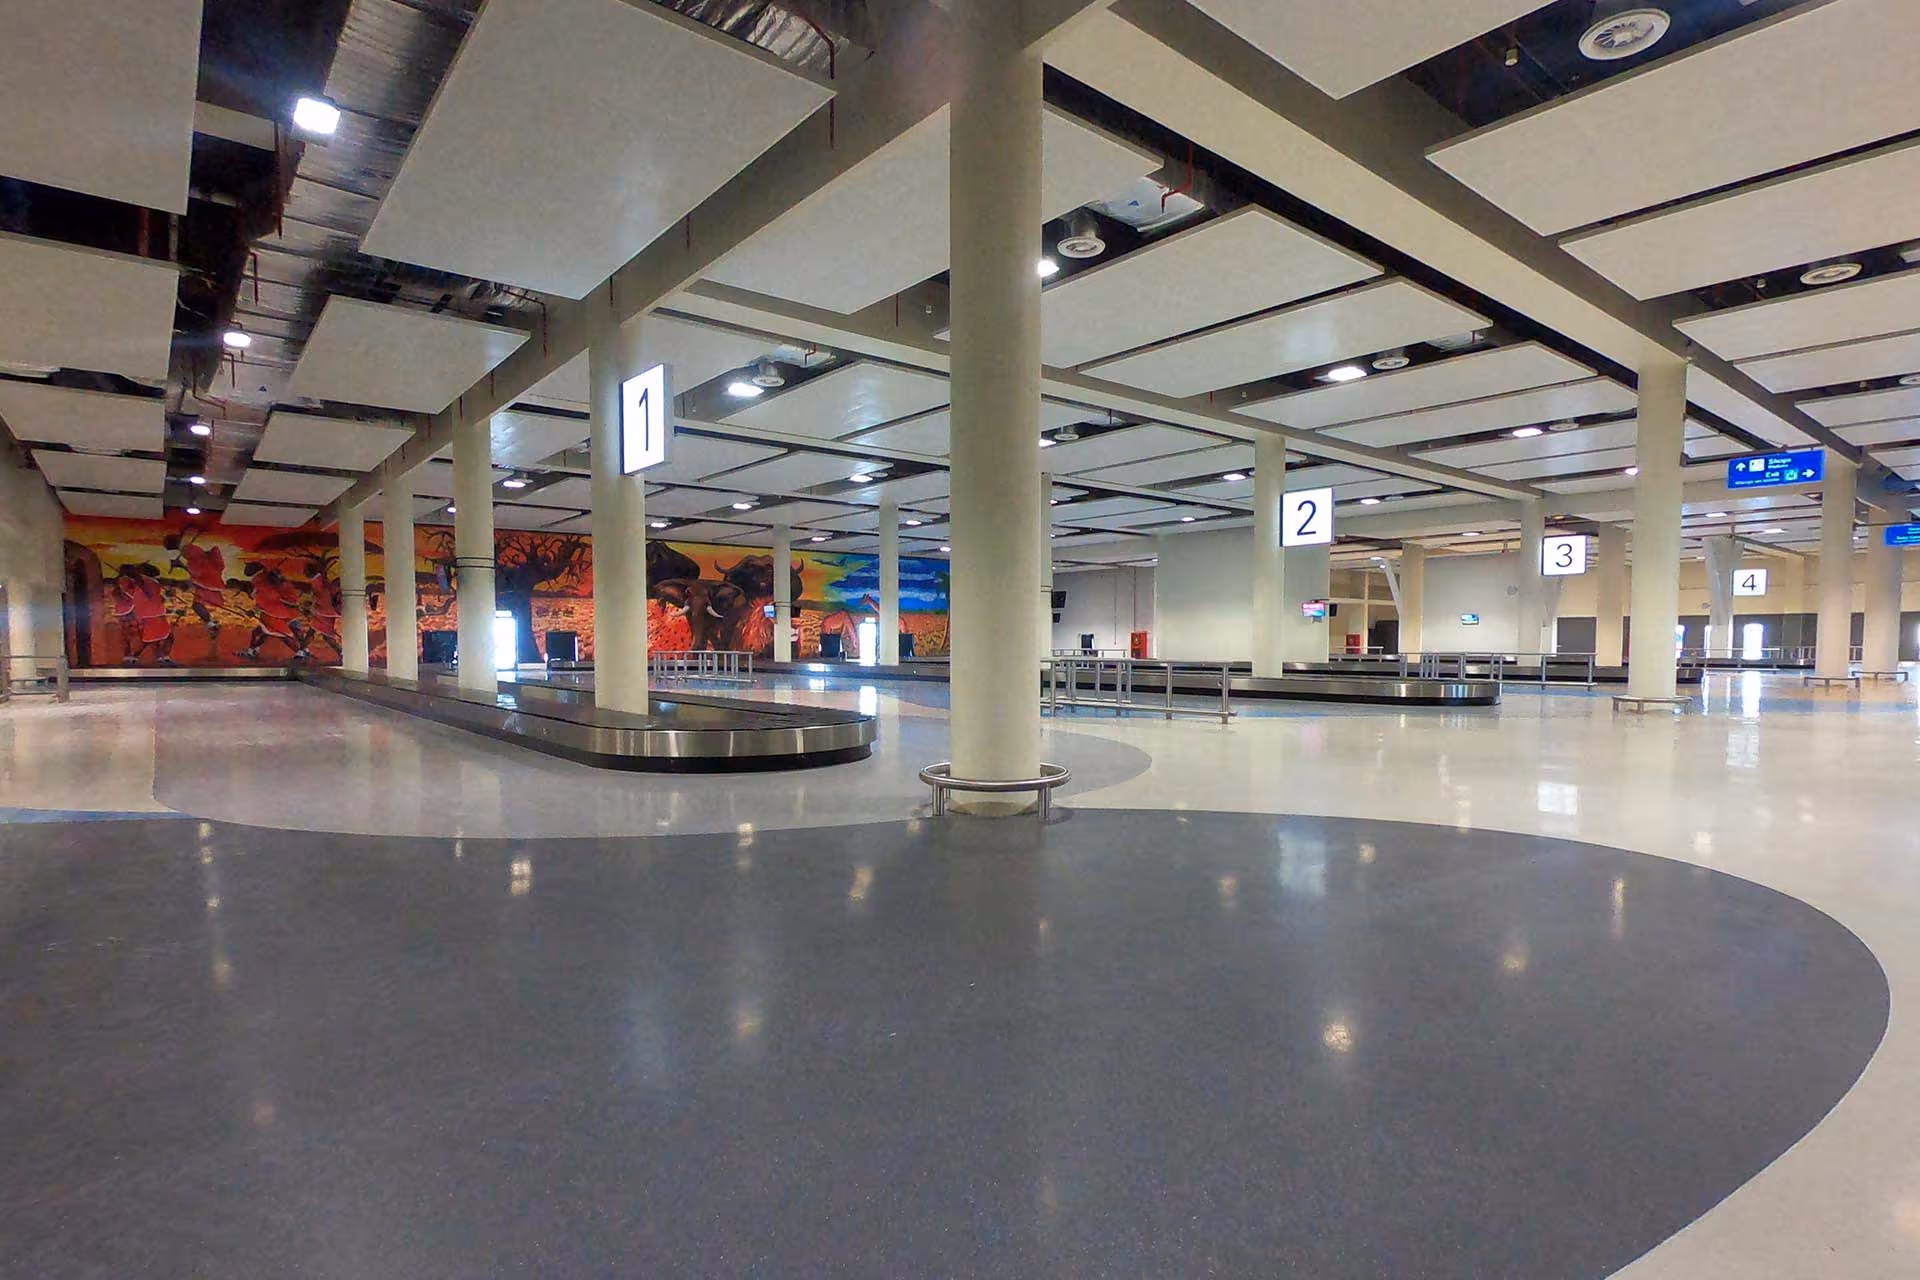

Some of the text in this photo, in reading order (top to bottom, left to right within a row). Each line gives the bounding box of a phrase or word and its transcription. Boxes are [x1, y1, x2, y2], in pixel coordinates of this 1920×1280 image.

[638, 387, 648, 451] 1
[1297, 500, 1317, 536] 2
[1556, 543, 1573, 568] 3
[1742, 573, 1758, 591] 4
